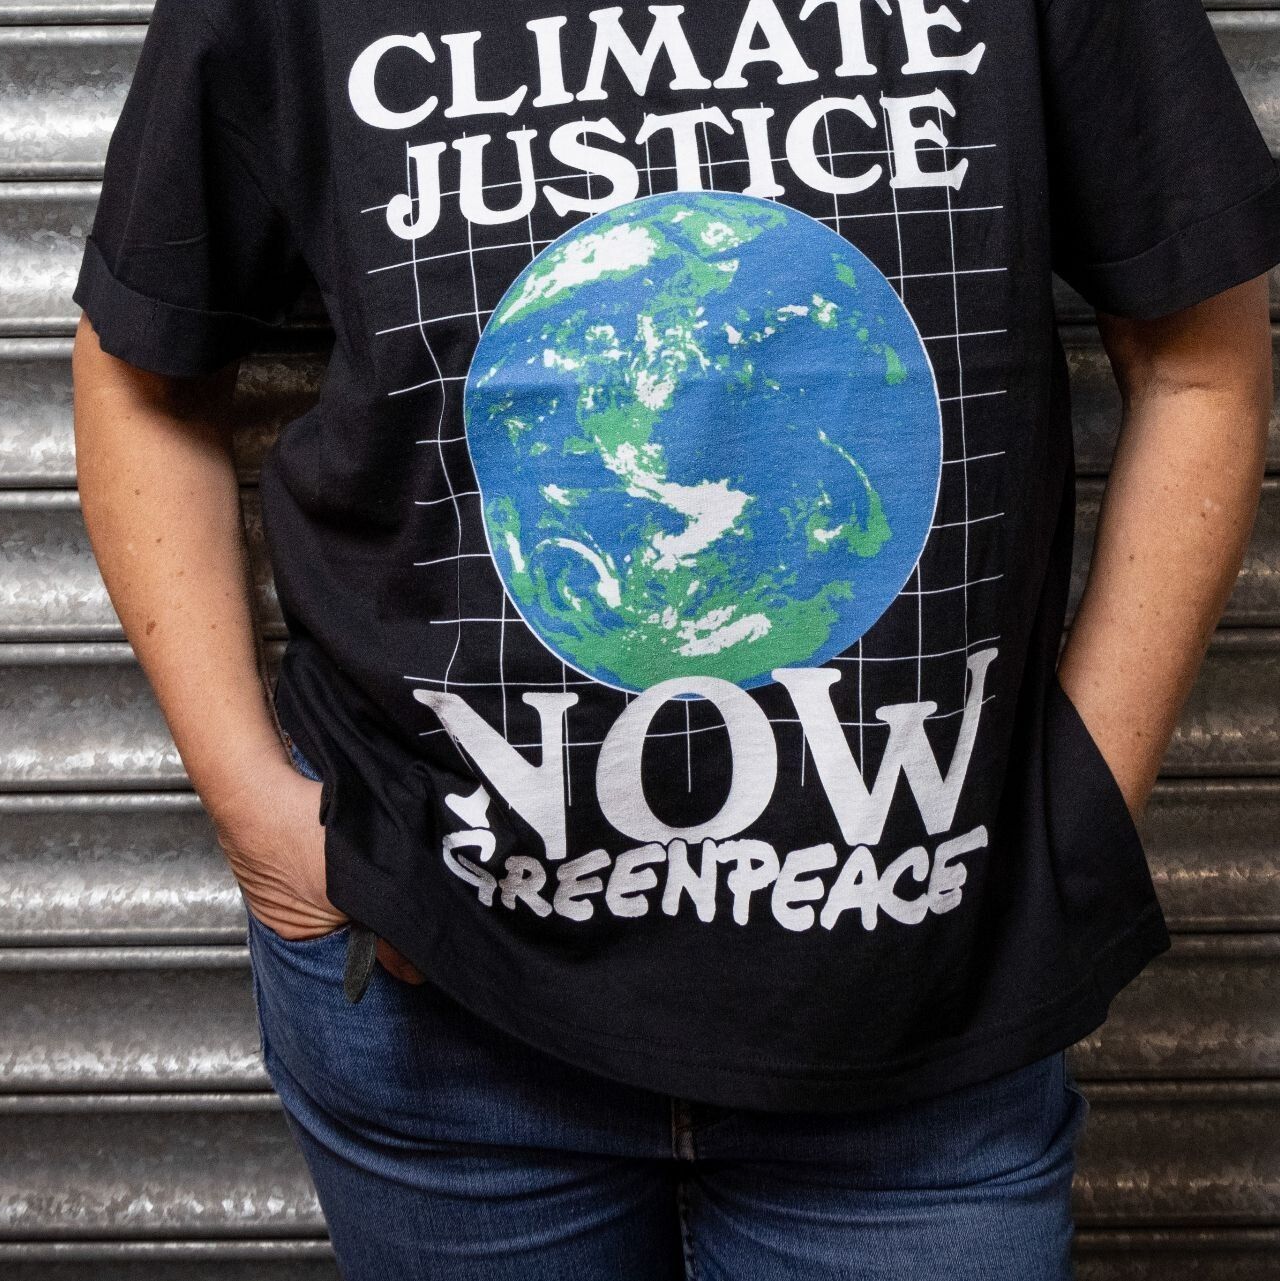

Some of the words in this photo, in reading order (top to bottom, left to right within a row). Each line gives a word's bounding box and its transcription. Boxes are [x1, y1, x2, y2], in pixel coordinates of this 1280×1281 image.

[386, 88, 970, 240] JUSTICE
[412, 647, 999, 860] NOW
[442, 825, 989, 932] GREENPEACE
